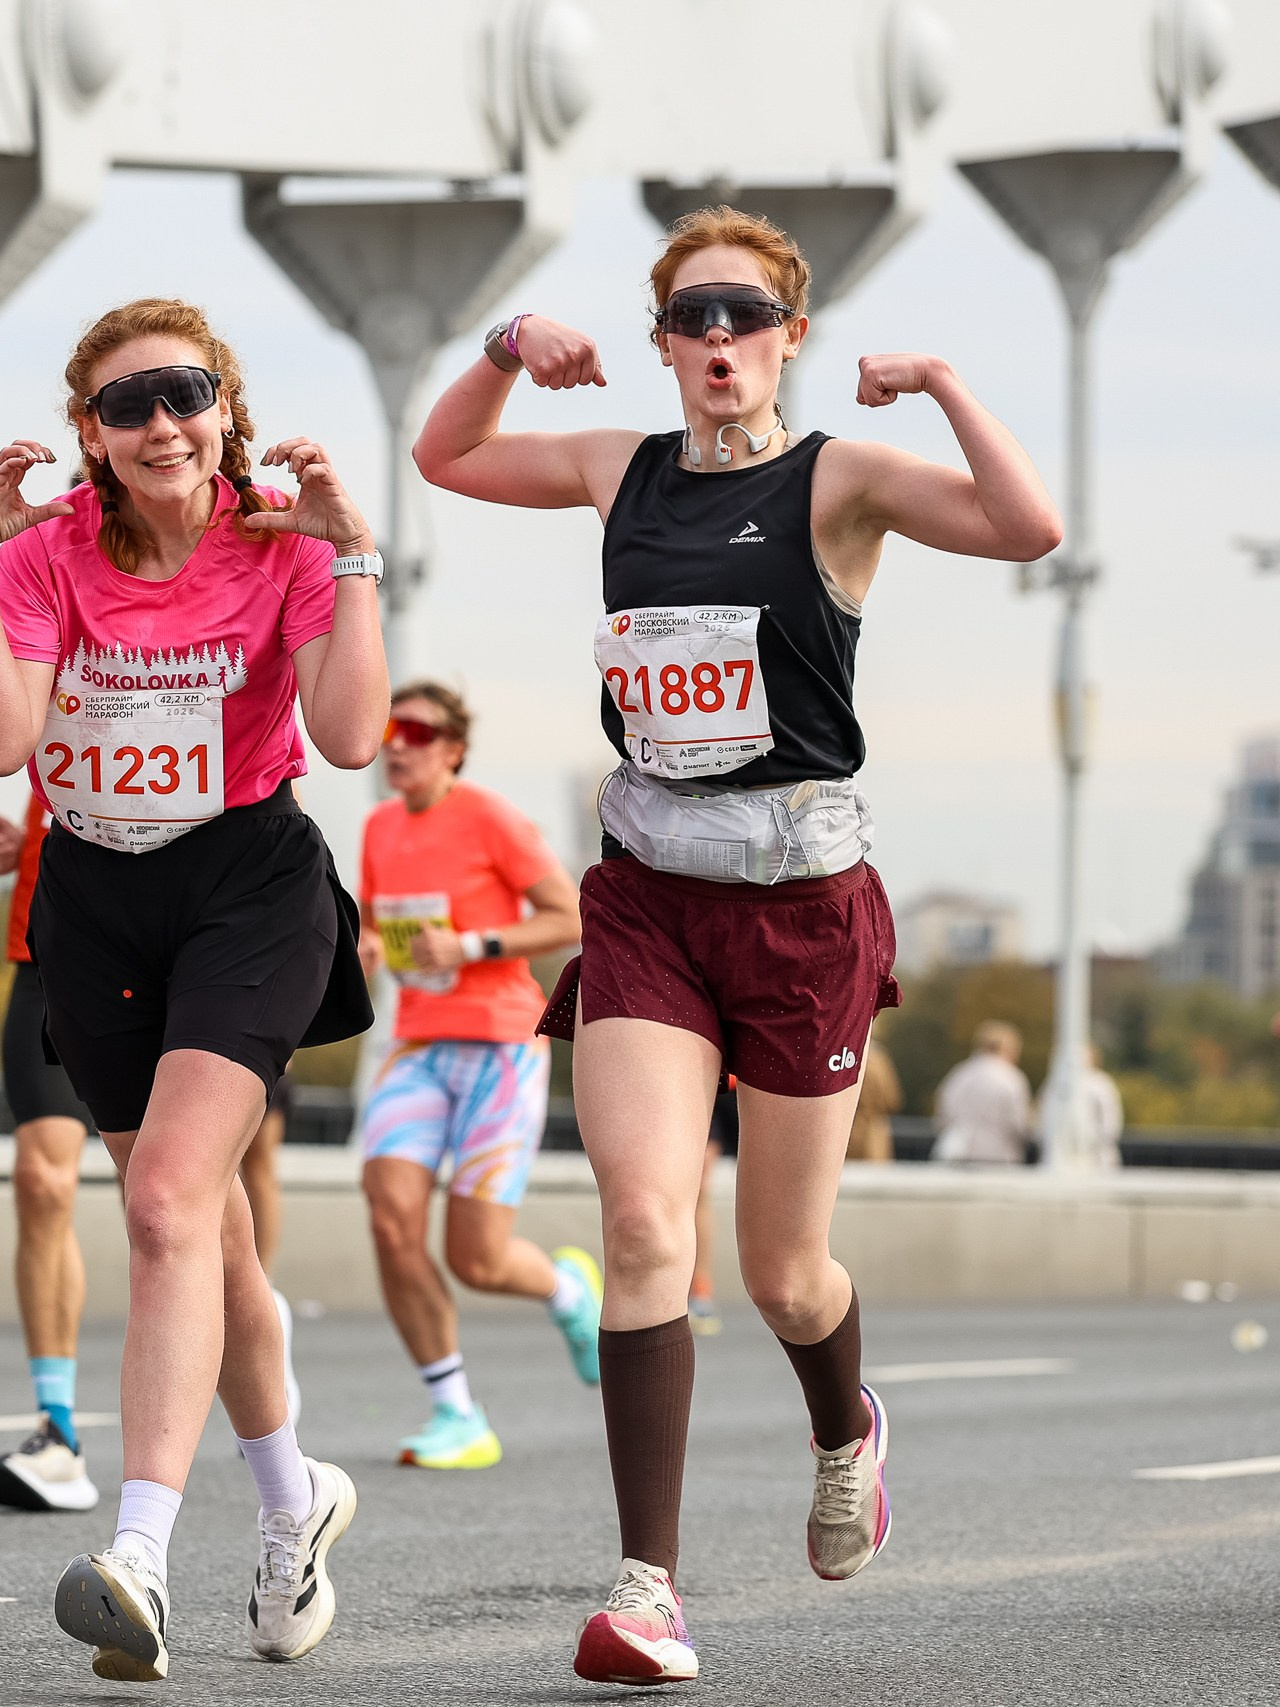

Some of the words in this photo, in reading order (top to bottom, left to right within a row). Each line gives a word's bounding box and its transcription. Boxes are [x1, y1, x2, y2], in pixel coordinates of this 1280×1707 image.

[728, 536, 767, 544] DEMIX
[721, 612, 737, 621] КМ
[634, 618, 690, 627] МОСКОВСКИЙ
[634, 627, 676, 636] МАРАФОН
[80, 664, 209, 691] SOKOLOVKA
[605, 659, 754, 716] 21887
[85, 695, 134, 703] СБЕРПРАЙМ
[160, 695, 181, 704] 42,2
[183, 695, 199, 703] КМ
[85, 702, 150, 711] МОСКОВСКИЙ
[85, 711, 134, 719] МАРАФОН
[44, 742, 209, 795] 21231
[66, 809, 85, 831] C
